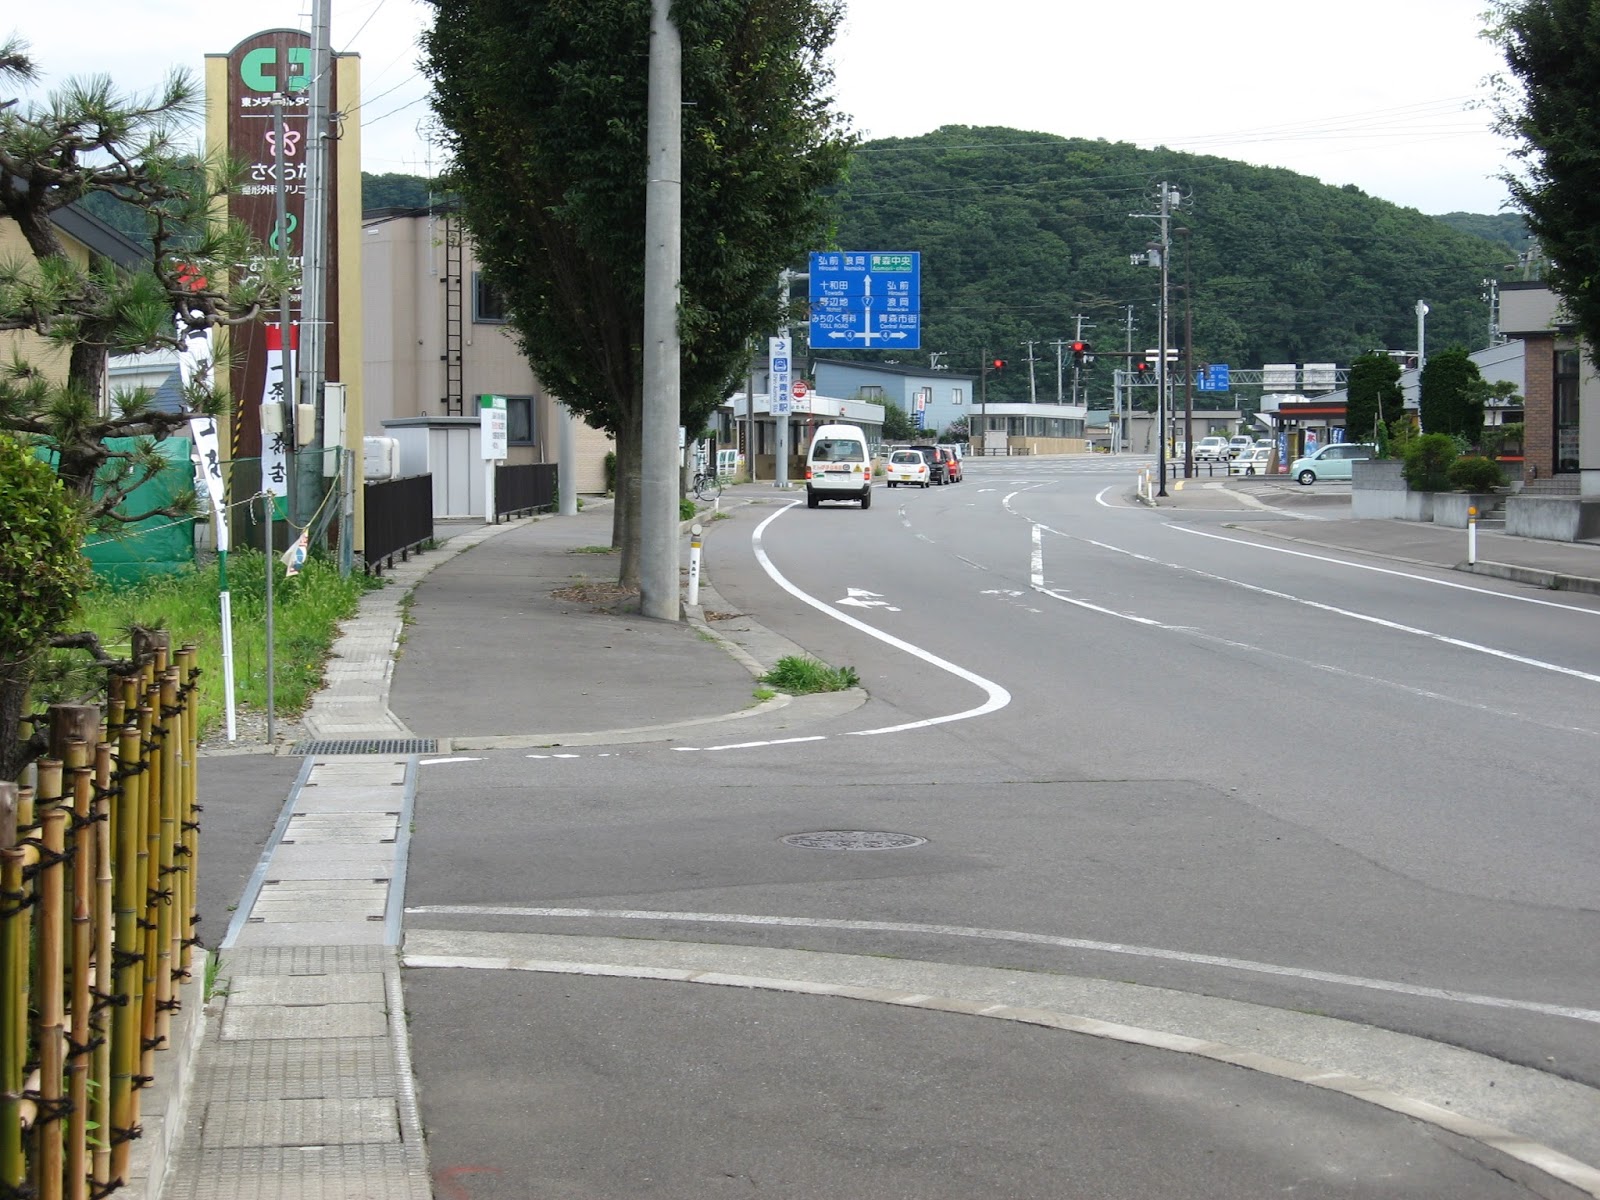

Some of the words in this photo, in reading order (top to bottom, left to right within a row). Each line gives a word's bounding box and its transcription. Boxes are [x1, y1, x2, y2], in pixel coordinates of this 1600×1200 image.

[818, 255, 839, 266] 弘前
[845, 255, 865, 266] 浪岡
[872, 256, 911, 266] 青森中央
[820, 280, 848, 290] 十和田
[887, 280, 909, 291] 弘前
[820, 297, 848, 307] 野辺地
[887, 297, 909, 307] 浪岡
[812, 314, 856, 323] みちのく有料
[879, 314, 917, 323] 青森市街
[778, 373, 788, 412] 新青森駅
